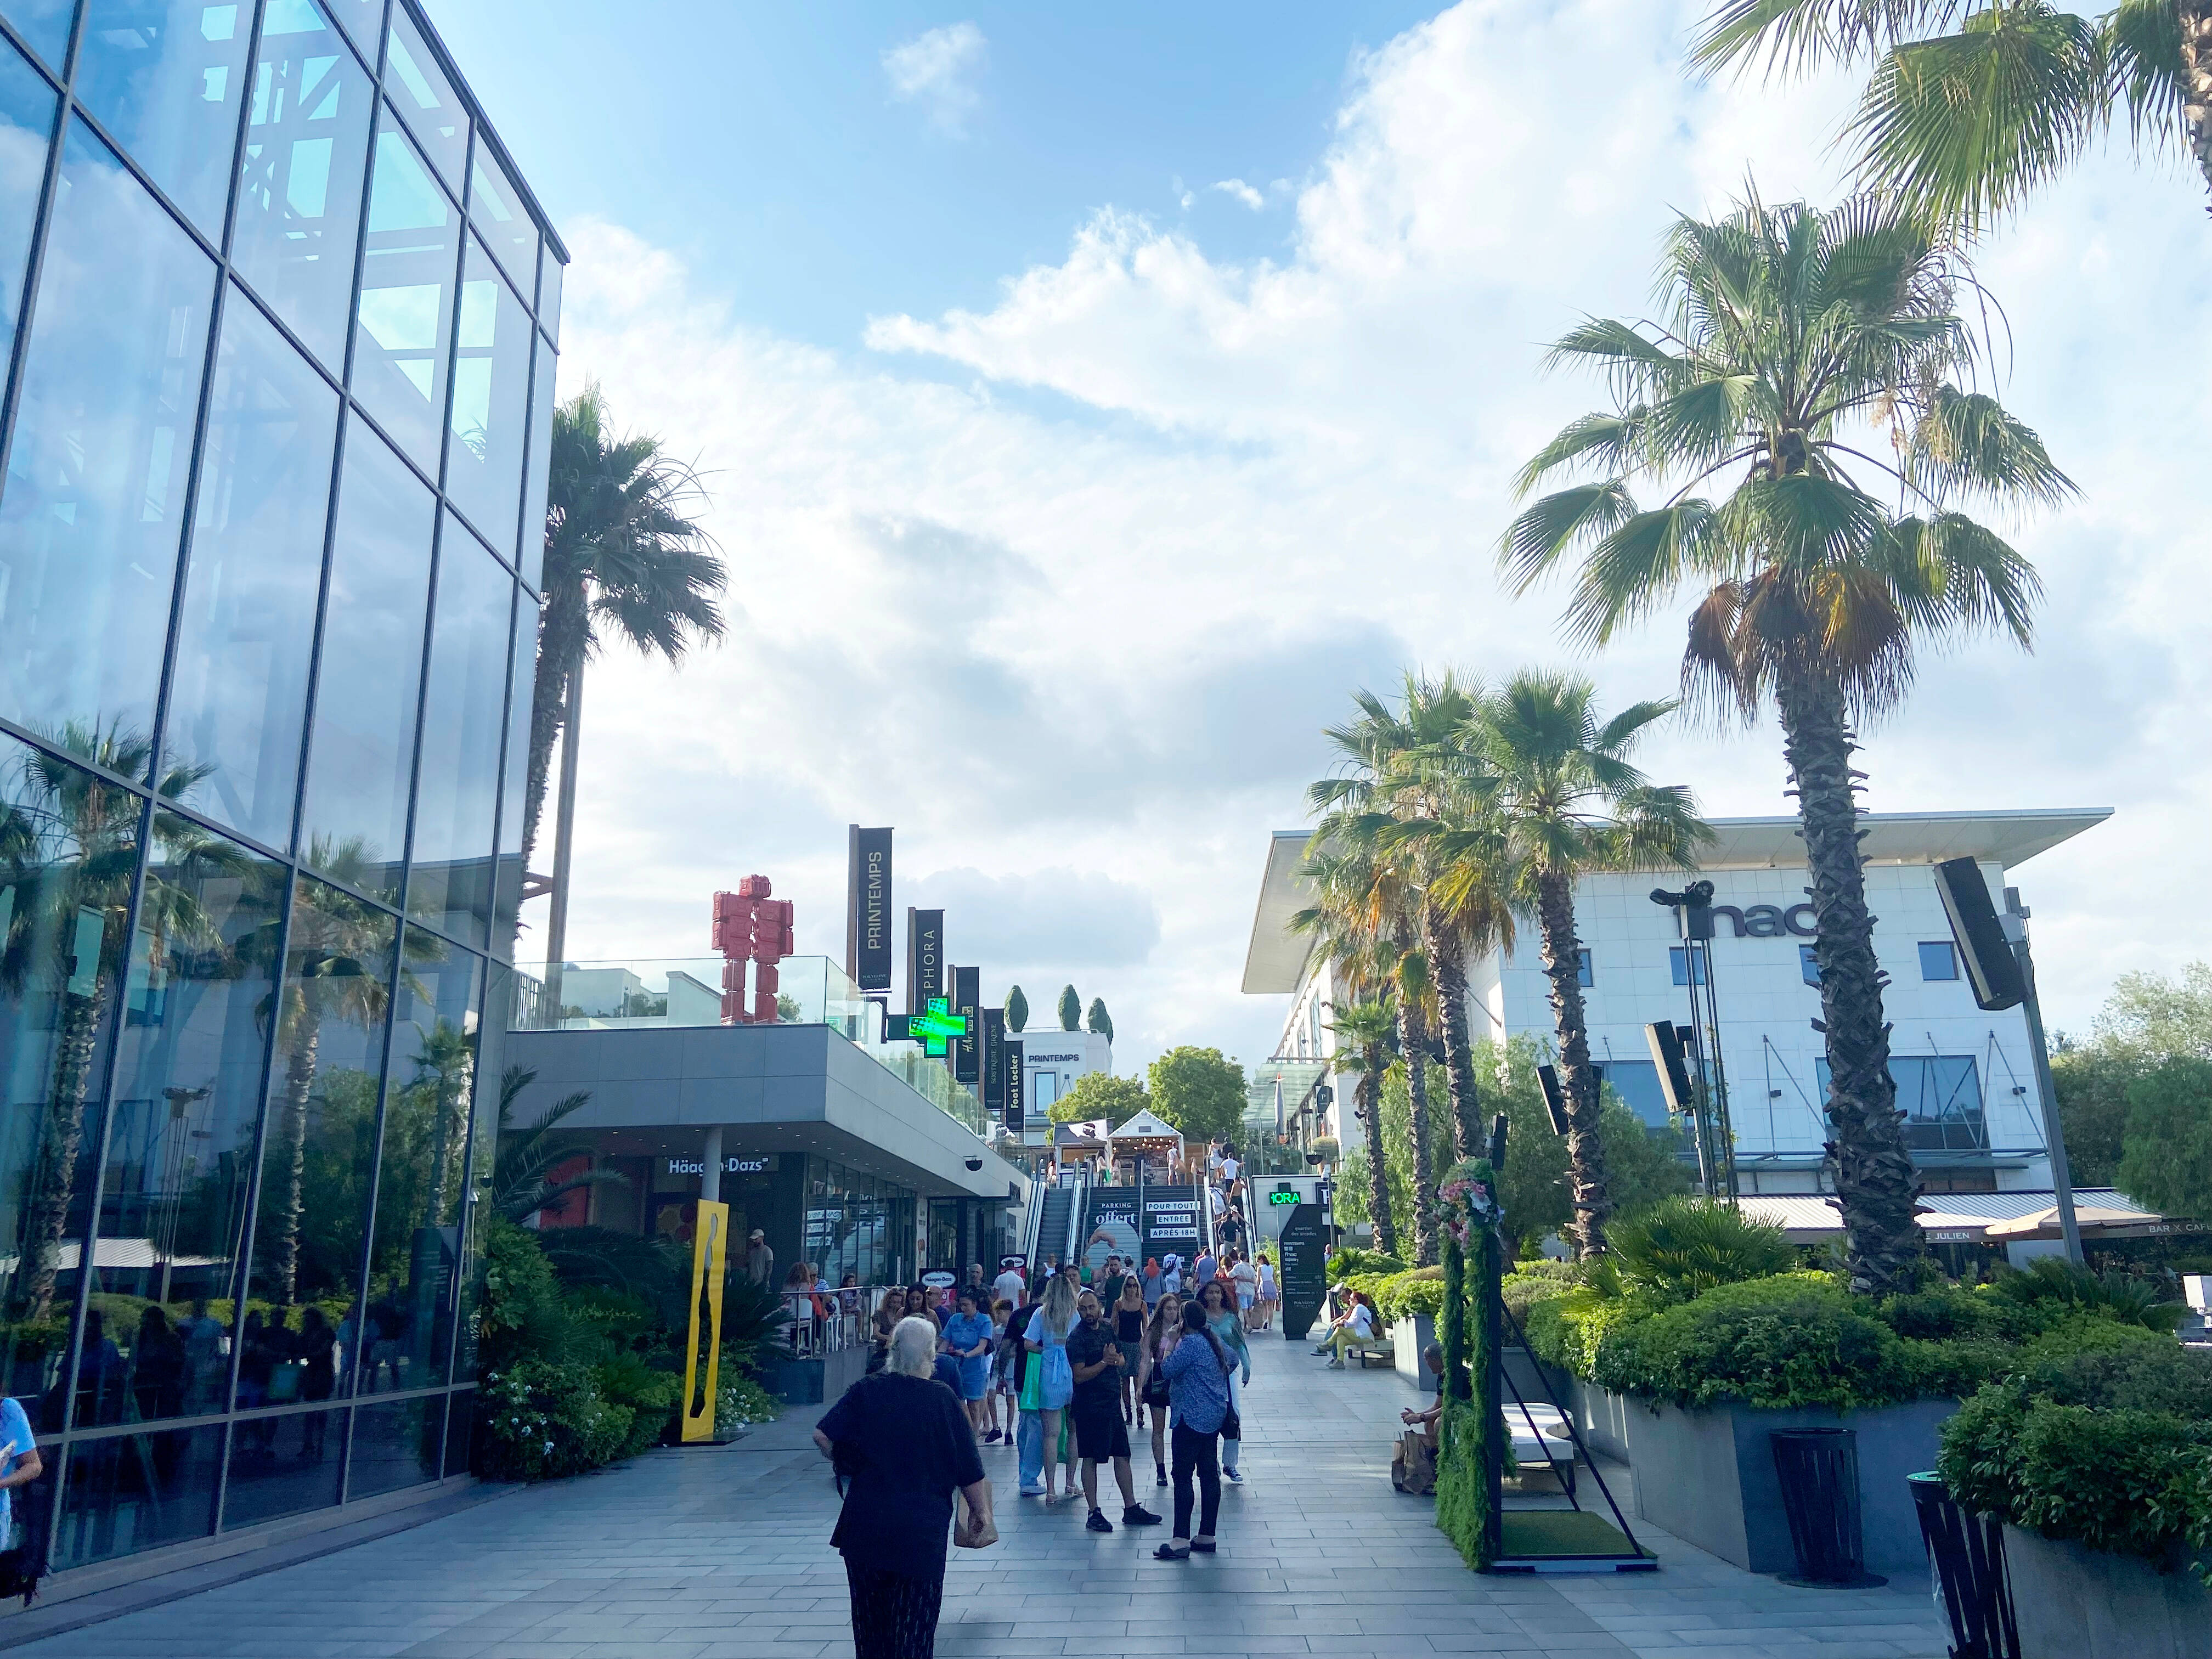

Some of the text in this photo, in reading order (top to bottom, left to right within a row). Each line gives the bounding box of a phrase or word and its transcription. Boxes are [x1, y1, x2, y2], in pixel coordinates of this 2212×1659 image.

[868, 851, 882, 949] PRINTEMPS
[1673, 904, 1819, 936] nac
[923, 930, 934, 1010] PHORA
[1029, 1054, 1079, 1063] PRINTEMPS
[1010, 1054, 1019, 1109] Foot Locker
[1095, 1210, 1136, 1224] offert
